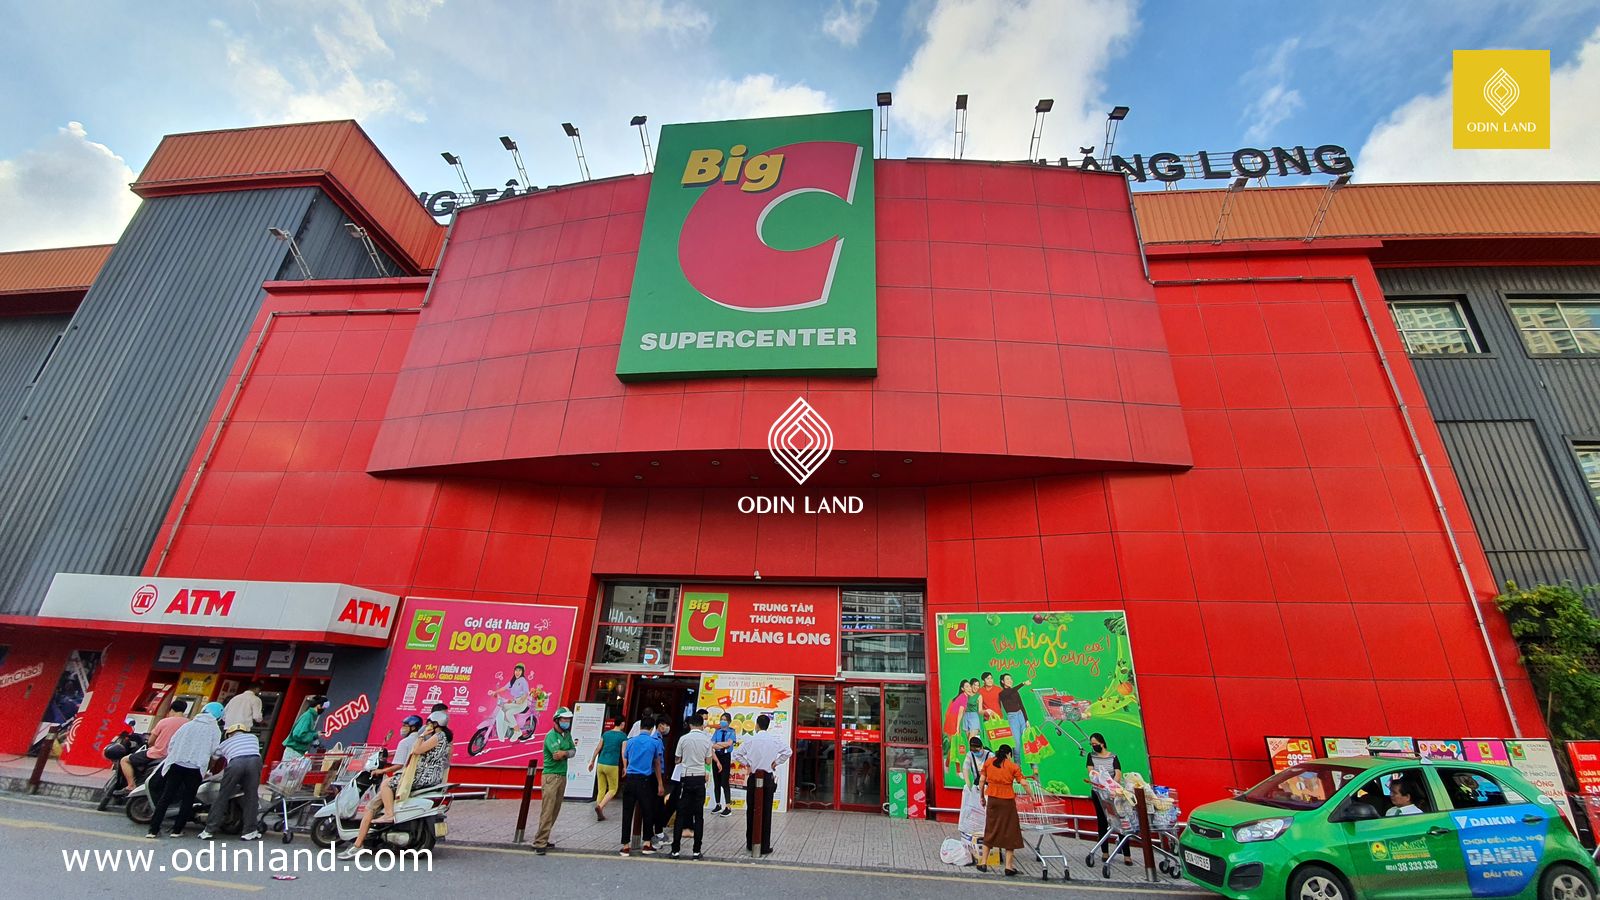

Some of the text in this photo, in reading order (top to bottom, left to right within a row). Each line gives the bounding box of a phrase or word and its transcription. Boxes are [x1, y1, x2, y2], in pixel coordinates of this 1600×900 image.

[1200, 144, 1354, 180] LONG
[678, 141, 864, 313] Big C
[639, 327, 857, 352] SUPERCENTER
[164, 588, 236, 617] ATM
[752, 602, 814, 613] TRUNG TÂM
[338, 598, 392, 628] ATM
[417, 614, 433, 623] Big
[687, 600, 726, 643] Big C
[749, 614, 816, 627] THƯƠNG MẠI
[464, 617, 530, 632] Gọi đặt hàng
[449, 631, 558, 655] 1900 1880
[730, 628, 831, 646] THĂNG LONG
[749, 688, 771, 704] ĐÃI
[324, 694, 369, 738] ATM
[1469, 816, 1516, 827] DAIKIN
[1408, 861, 1423, 871] 333
[1423, 859, 1438, 869] 333
[1466, 846, 1537, 866] DAIKIN
